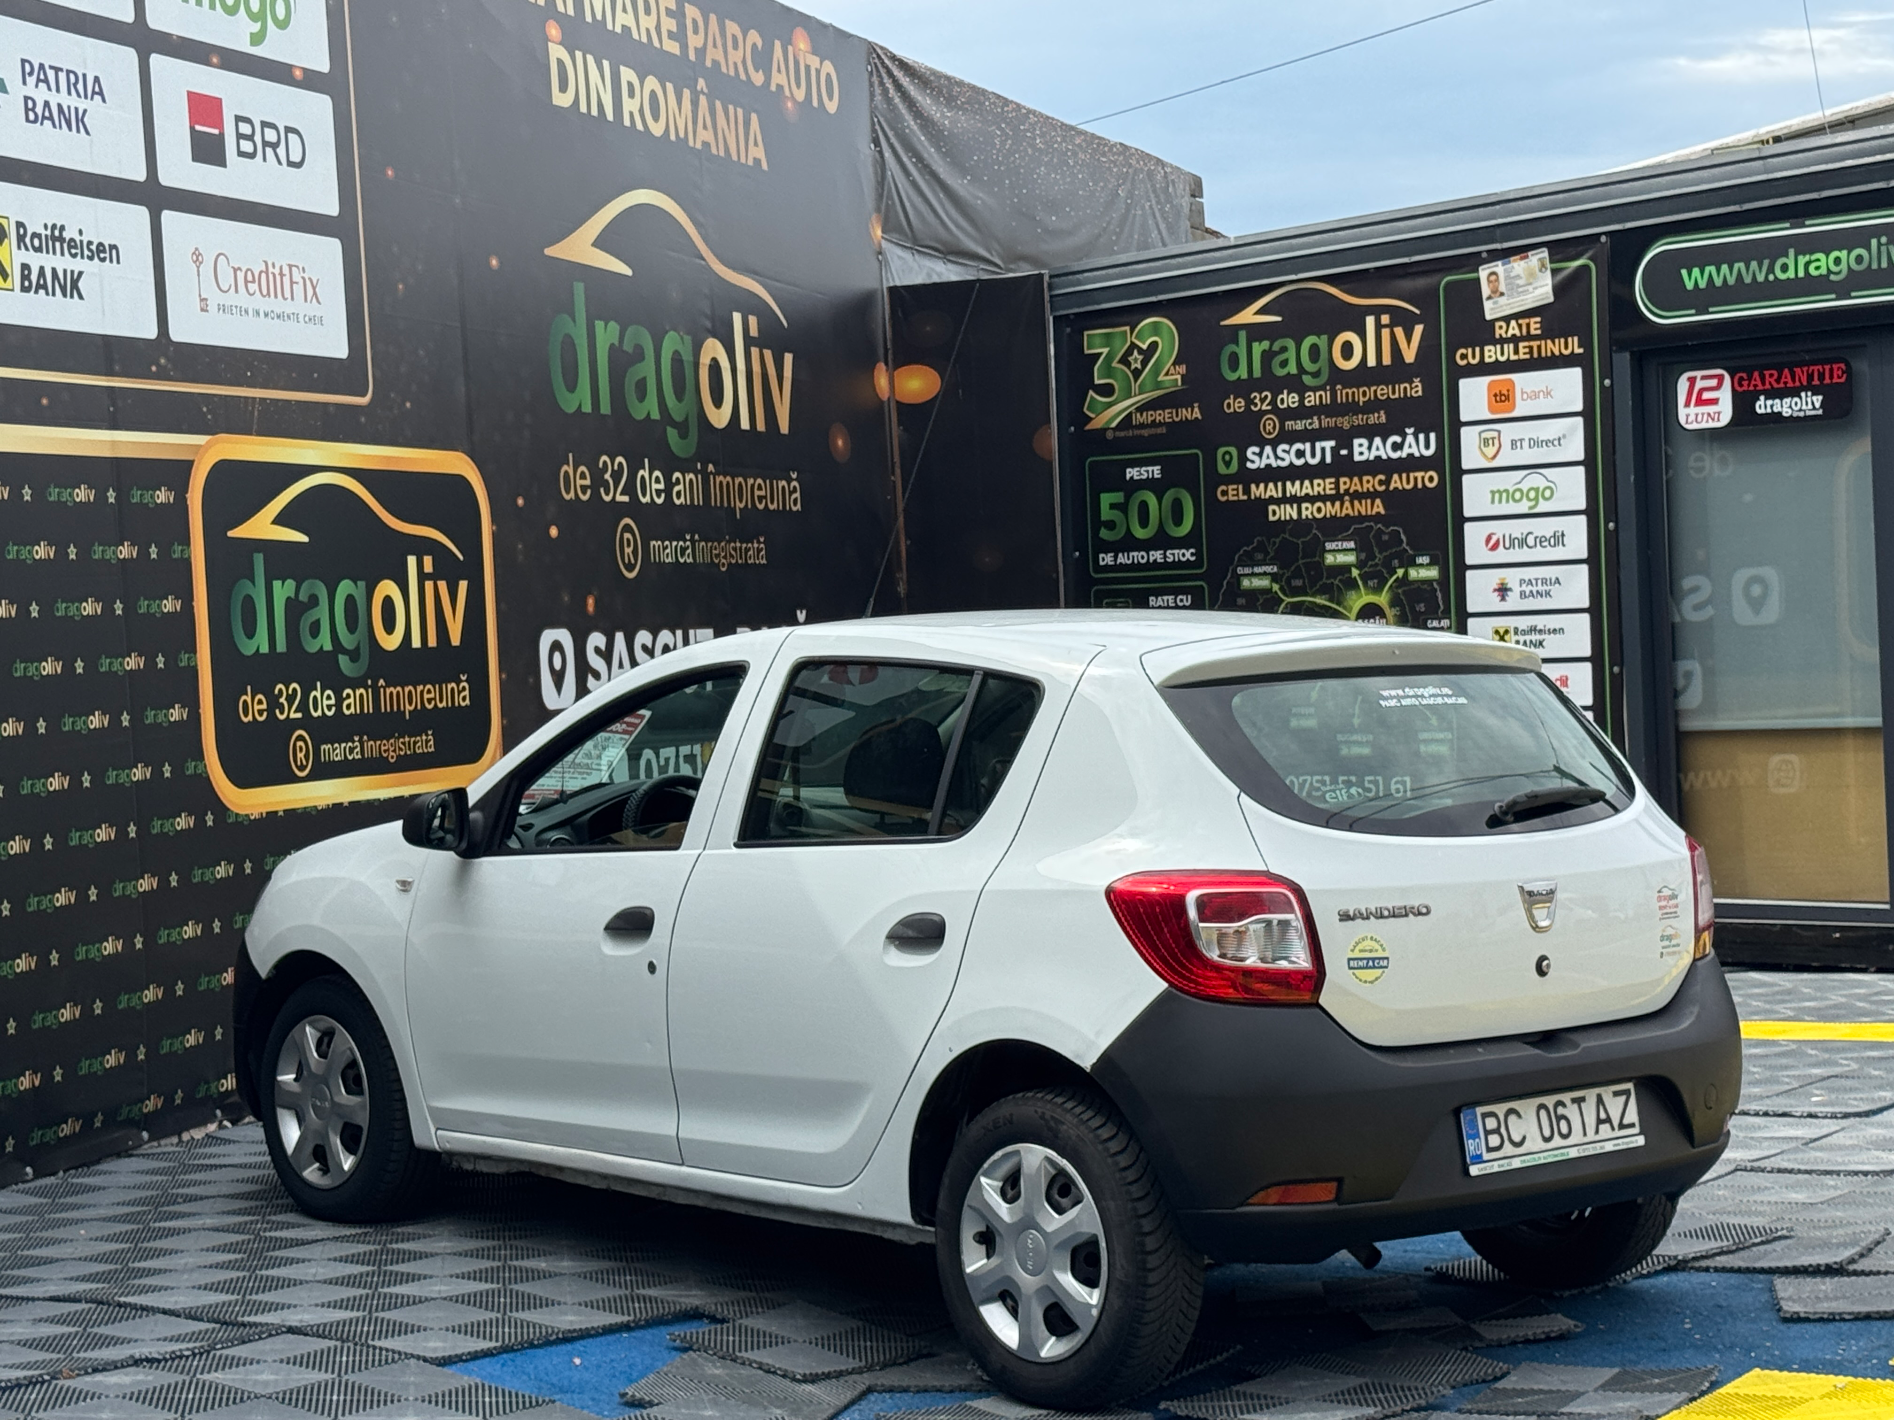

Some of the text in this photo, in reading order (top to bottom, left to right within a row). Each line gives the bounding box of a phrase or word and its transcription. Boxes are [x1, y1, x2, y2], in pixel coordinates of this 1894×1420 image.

[684, 2, 765, 87] PARC
[769, 39, 839, 115] AUTO
[20, 58, 107, 104] PATRIA
[23, 95, 91, 137] BANK
[547, 42, 768, 171] DIN ROMÂNIA
[234, 114, 306, 169] BRD
[15, 220, 121, 265] Raiffeisen
[19, 263, 85, 300] BANK
[213, 252, 322, 305] CreditFix
[217, 303, 250, 318] PRIETEN
[252, 307, 261, 319] IN
[263, 309, 300, 324] MOMENTE
[1494, 317, 1541, 339] RATE
[1220, 314, 1424, 387] dragoliv
[1455, 336, 1584, 366] CU BULETINUL
[550, 281, 794, 458] dragoliv
[1083, 317, 1182, 419] 32
[1168, 364, 1186, 376] ANI
[1733, 363, 1847, 392] GARANTIE
[1223, 378, 1423, 413] de 32 de ani împreună
[1492, 386, 1554, 404] tbi bank
[1683, 373, 1725, 408] 12
[1132, 403, 1202, 426] ÎMPREUNĂ
[1755, 390, 1823, 417] dragoliv
[1285, 413, 1319, 431] marcă
[1321, 410, 1386, 430] înregistrată
[1685, 411, 1722, 425] LUNI
[1246, 440, 1336, 469] SASCUT
[1352, 427, 1436, 462] BACĂU
[1483, 436, 1497, 448] BT
[1510, 438, 1525, 451] BT
[559, 453, 802, 519] de 32 de ani împreună
[1126, 466, 1162, 481] PESTE
[1217, 471, 1438, 501] CEL MAI MARE PARC AUTO
[47, 483, 95, 506] dragoliv
[130, 486, 175, 507] dragoliv
[1490, 485, 1555, 511] mogo
[1099, 487, 1194, 541] 500
[1268, 496, 1385, 521] DIN ROMÂNIA
[5, 541, 56, 564] dragoliv
[91, 541, 138, 564] dragoliv
[650, 534, 694, 563] marcă
[696, 534, 767, 571] înregistrată
[1502, 530, 1566, 551] UniCredit
[1099, 549, 1197, 566] DE AUTO PE STOC
[1519, 576, 1561, 588] PATRIA
[1519, 589, 1553, 600] BANK
[54, 598, 102, 620] dragoliv
[137, 595, 182, 617] dragoliv
[1149, 595, 1191, 607] RATE CU
[231, 553, 468, 678] dragoliv
[1513, 625, 1565, 637] Raiffeisen
[12, 657, 63, 680] dragoliv
[98, 652, 145, 675] dragoliv
[239, 674, 470, 723] de 32 de ani împreună
[61, 711, 109, 733] dragoliv
[144, 704, 188, 726] dragoliv
[321, 736, 361, 763] marcă
[363, 729, 435, 763] înregistrată
[19, 772, 70, 797] dragoliv
[105, 763, 151, 787] dragoliv
[1364, 776, 1383, 797] 51
[1390, 776, 1411, 798] 61
[68, 824, 116, 847] dragoliv
[150, 813, 195, 836] dragoliv
[191, 861, 234, 884] dragoliv
[112, 873, 159, 898] dragoliv
[26, 887, 77, 912] dragoliv
[1338, 903, 1432, 922] SANDERO
[157, 920, 202, 944] dragoliv
[74, 935, 123, 962] dragoliv
[1350, 959, 1367, 968] RENT
[1374, 959, 1388, 967] CAR
[197, 967, 235, 992] dragoli
[117, 984, 164, 1010] dragoliv
[31, 1002, 82, 1029] dragoliv
[159, 1029, 204, 1054] dragoliv
[77, 1049, 126, 1075] dragoliv
[195, 1073, 236, 1097] dragoli
[117, 1095, 164, 1121] dragoliv
[29, 1118, 82, 1146] dragoliv
[1480, 1107, 1527, 1154] BC
[1467, 1138, 1481, 1155] RO
